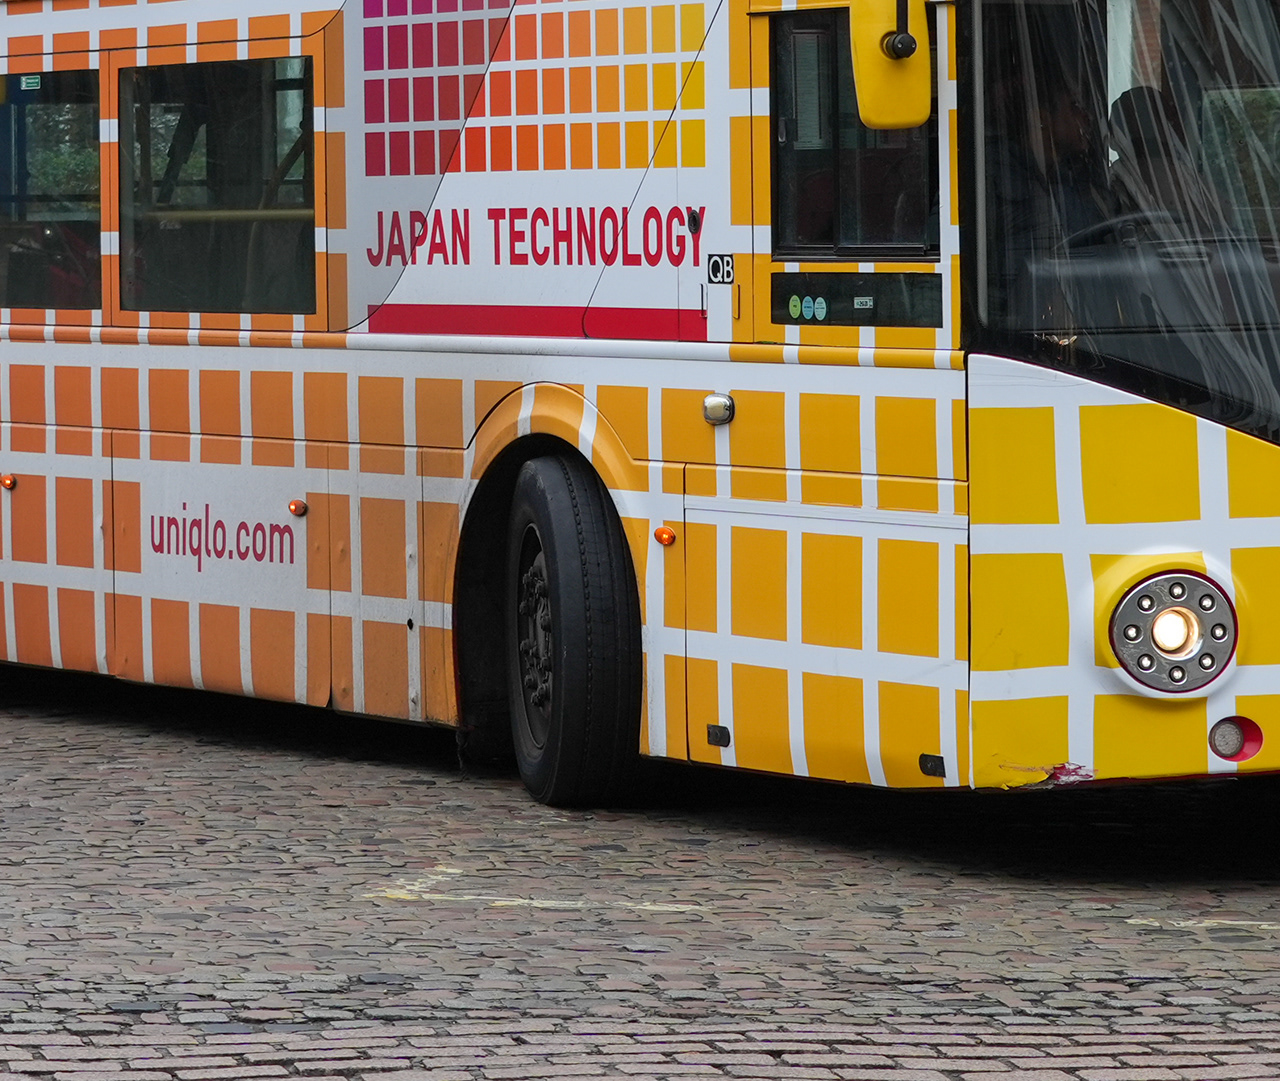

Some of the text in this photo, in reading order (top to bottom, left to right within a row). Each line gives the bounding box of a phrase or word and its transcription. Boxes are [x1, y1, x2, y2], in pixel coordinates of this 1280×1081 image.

[366, 206, 706, 267] JAPAN TECHNOLOGY
[709, 255, 734, 283] QB
[150, 502, 294, 572] uniqlo.com
